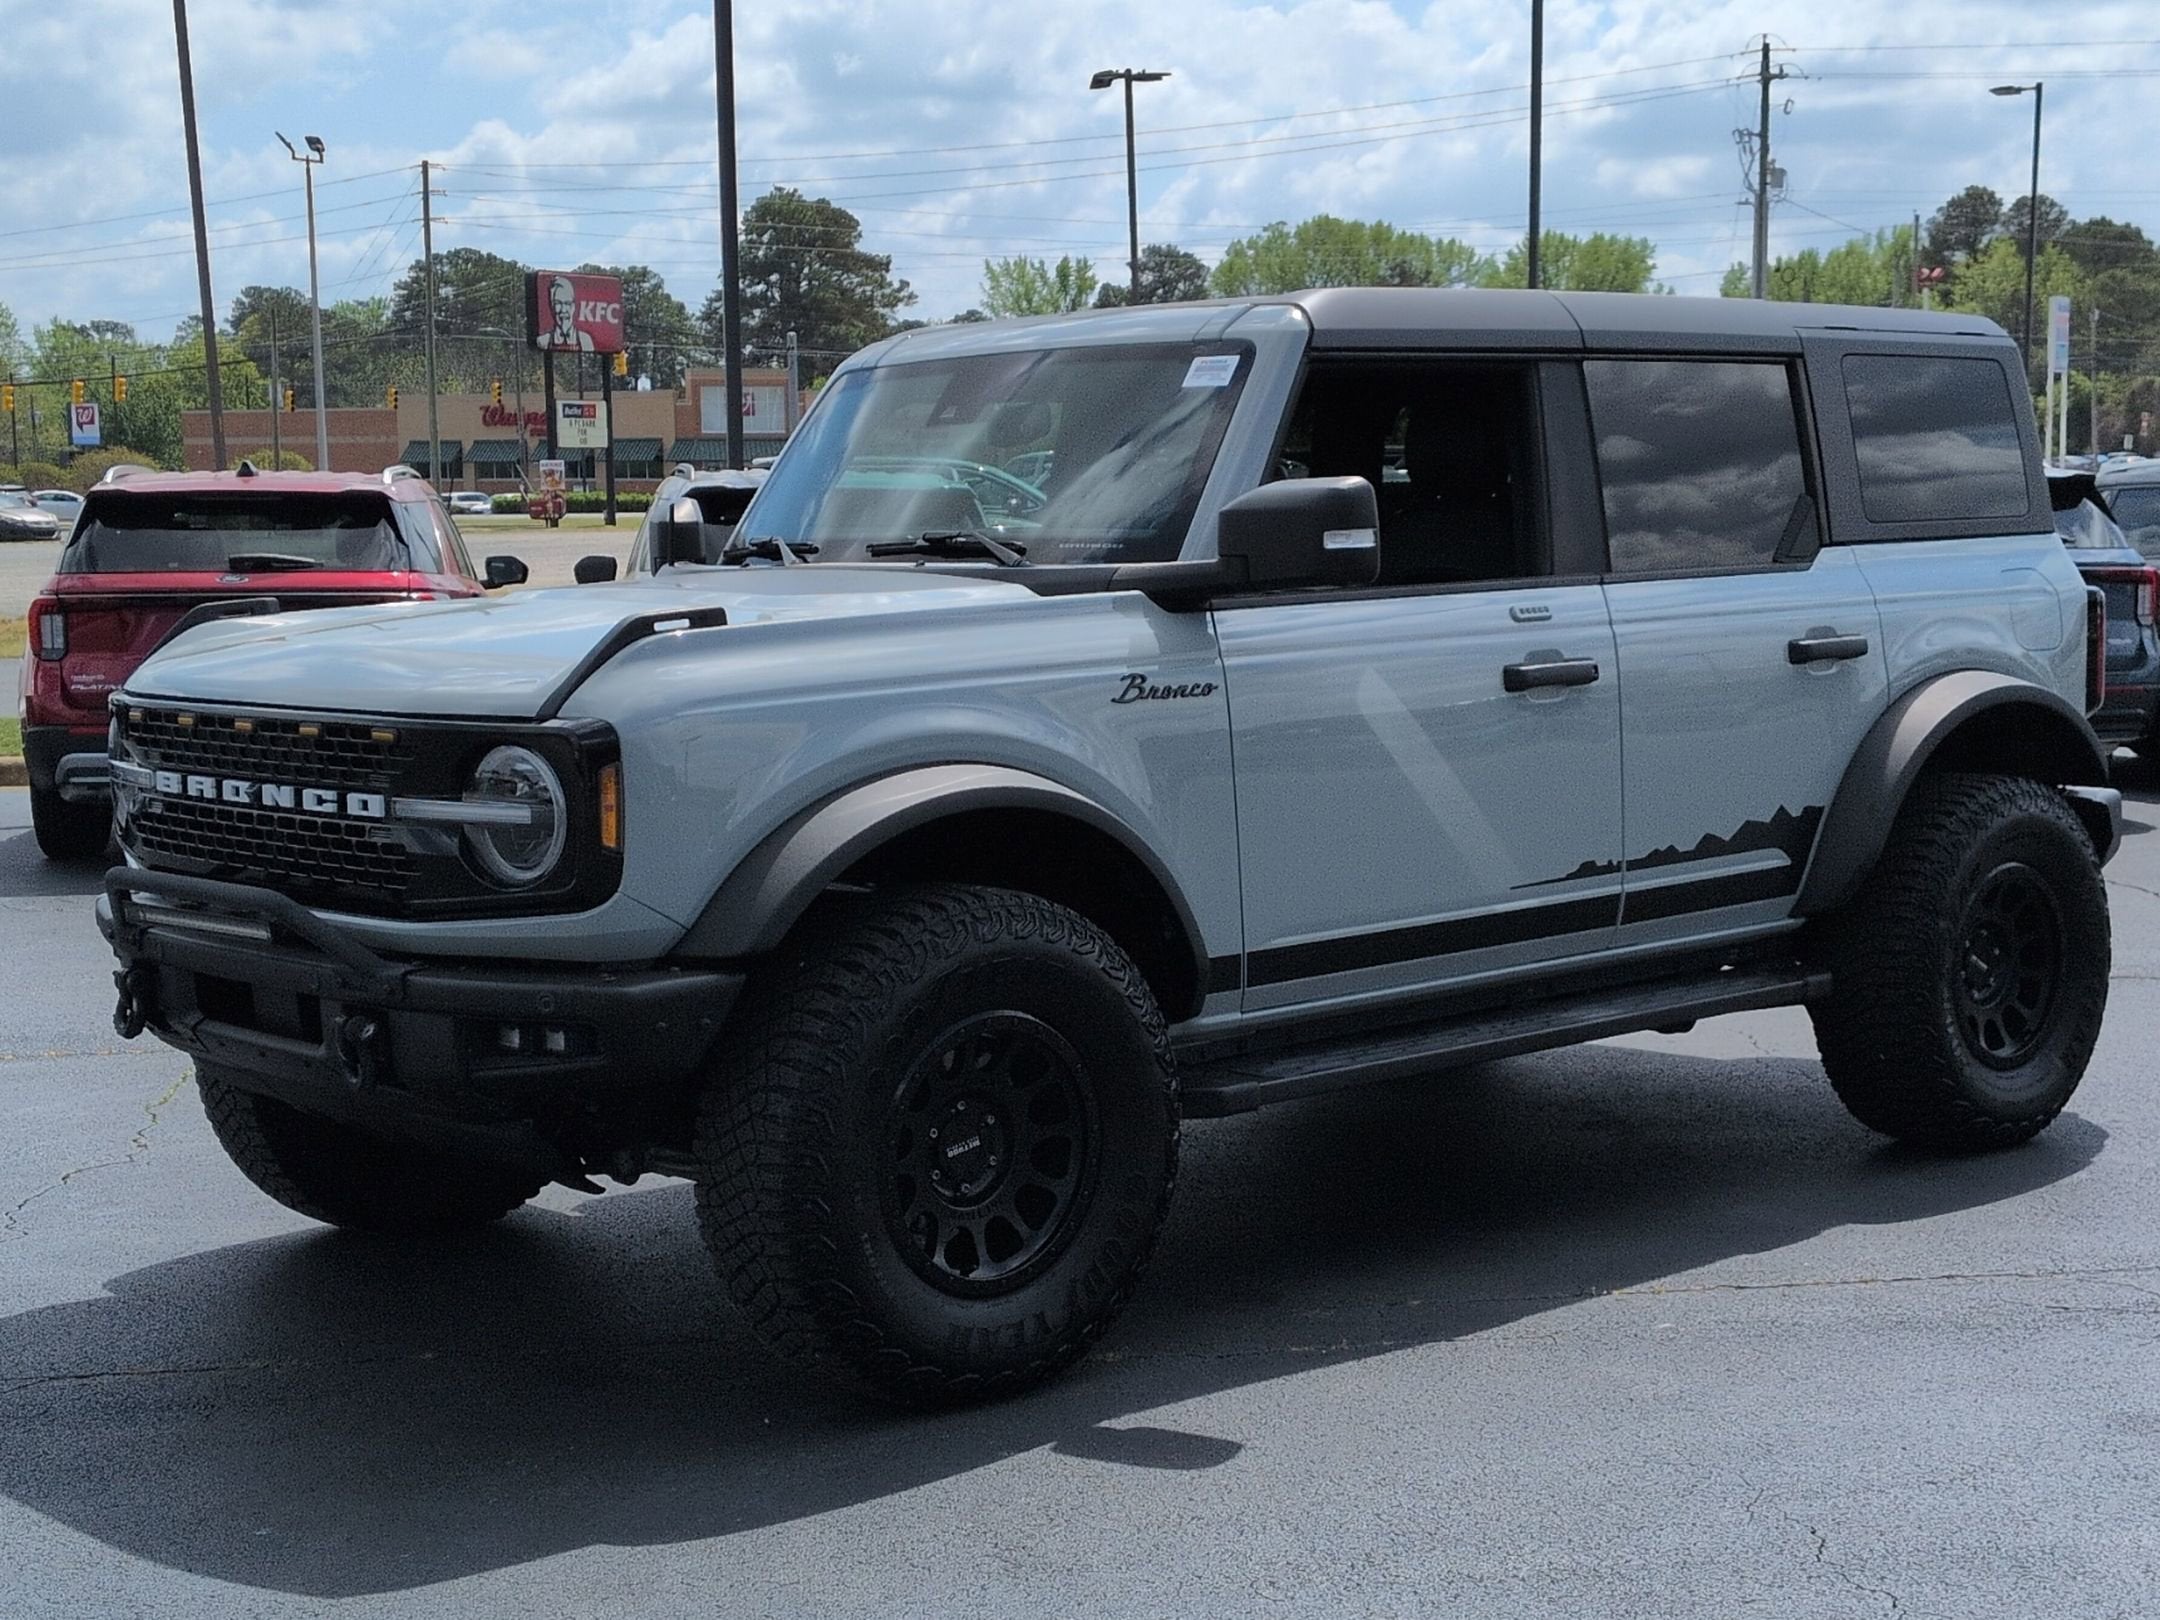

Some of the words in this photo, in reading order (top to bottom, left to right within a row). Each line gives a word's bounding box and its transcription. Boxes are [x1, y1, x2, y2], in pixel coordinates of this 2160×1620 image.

[579, 300, 620, 324] KFC
[1110, 672, 1219, 704] Bronco
[155, 770, 387, 818] BRONCO
